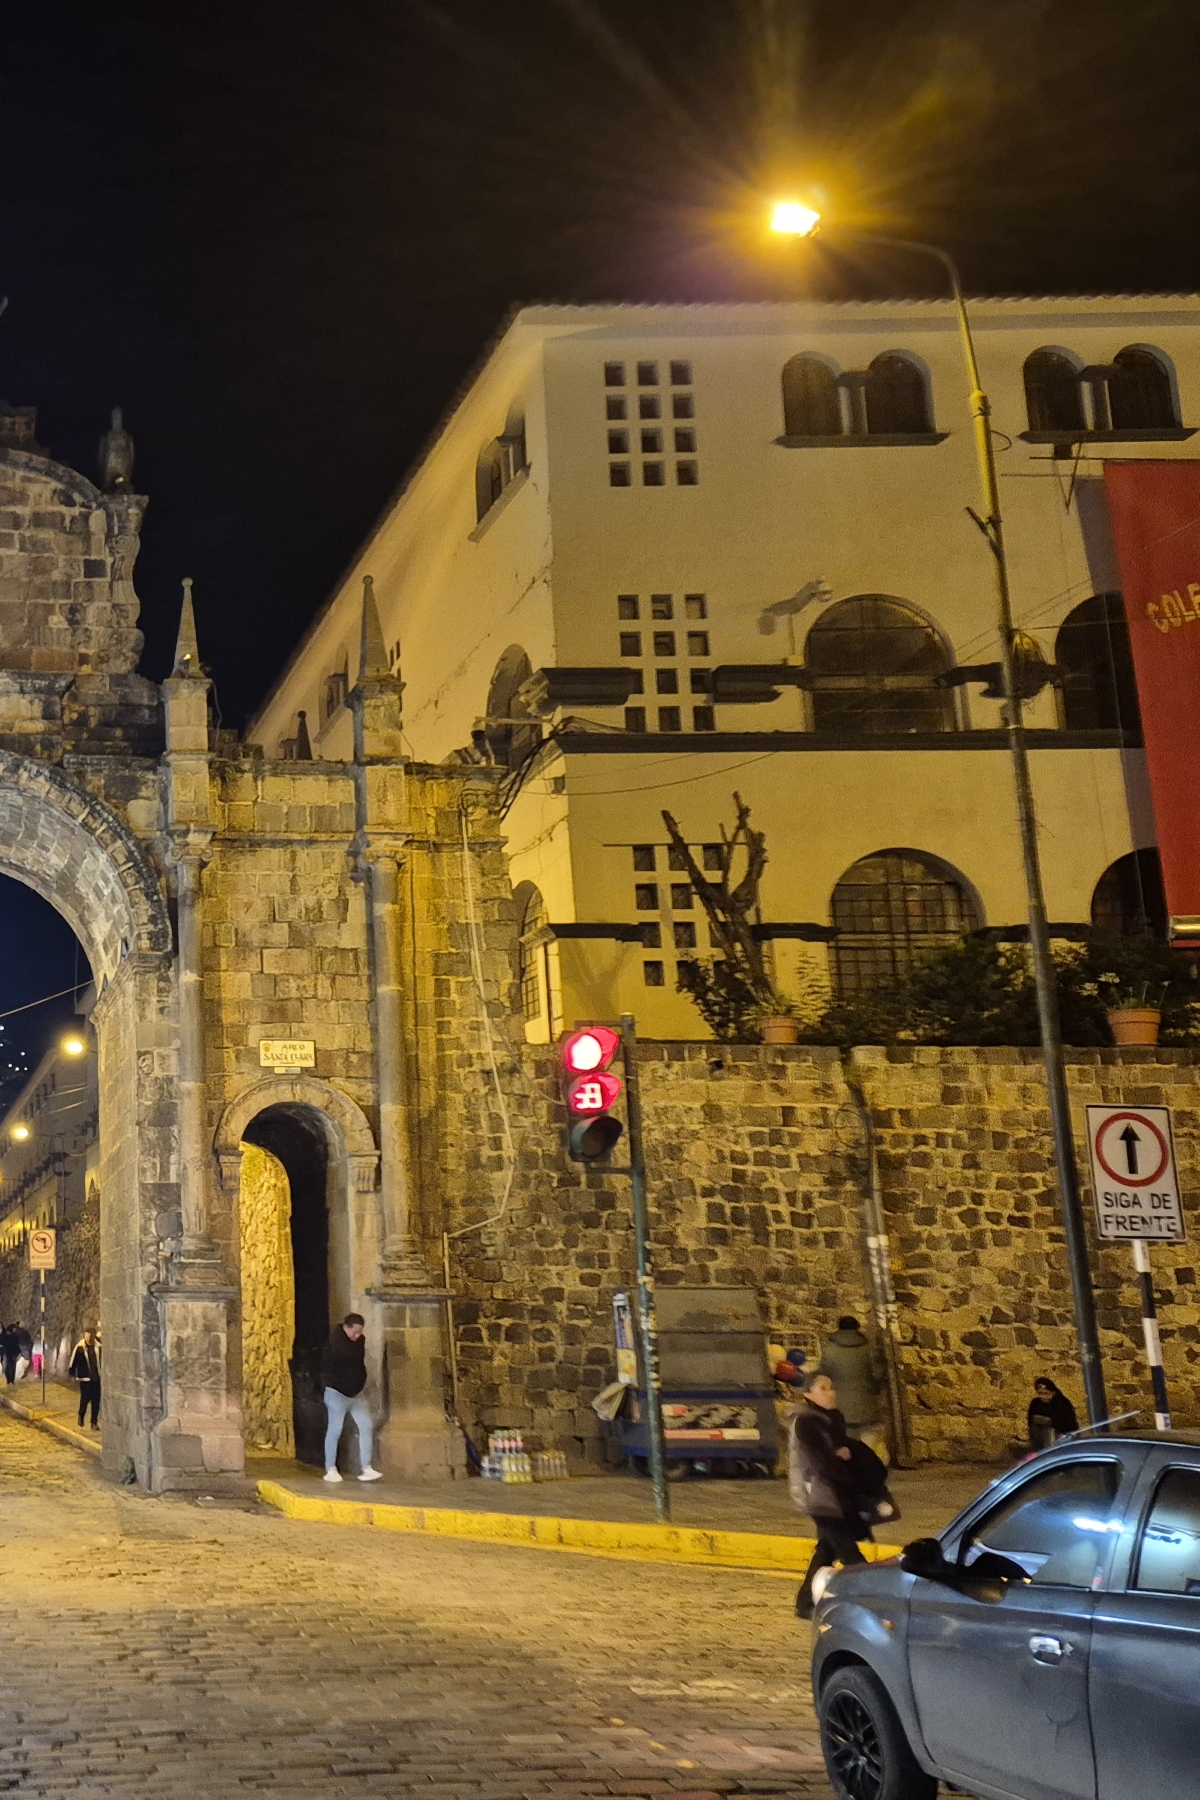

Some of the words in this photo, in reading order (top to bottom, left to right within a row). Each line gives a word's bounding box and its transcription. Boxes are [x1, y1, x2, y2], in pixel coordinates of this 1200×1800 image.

[281, 1043, 305, 1051] ARCO
[263, 1053, 288, 1061] SANTA
[290, 1053, 314, 1061] CLARA
[1103, 1191, 1142, 1209] SIGA
[1151, 1193, 1173, 1209] DE
[1103, 1214, 1178, 1233] FRENTE
